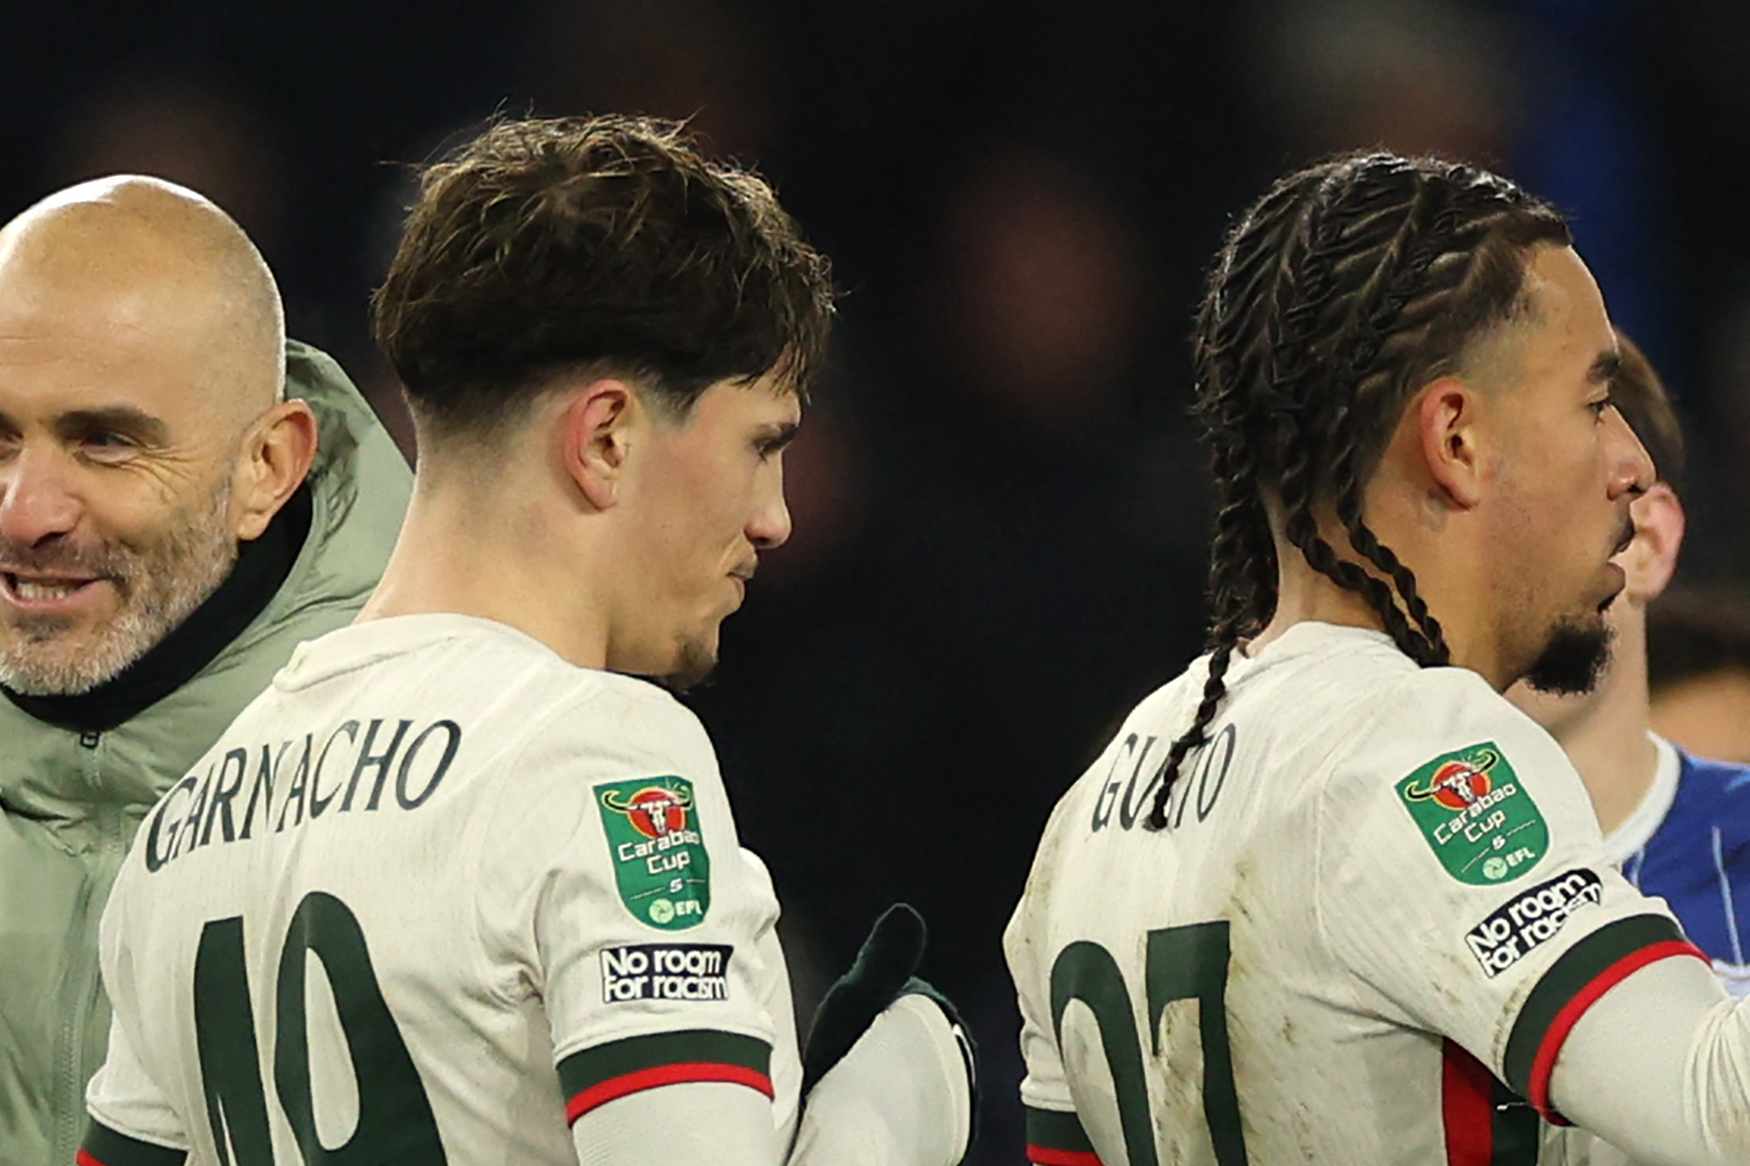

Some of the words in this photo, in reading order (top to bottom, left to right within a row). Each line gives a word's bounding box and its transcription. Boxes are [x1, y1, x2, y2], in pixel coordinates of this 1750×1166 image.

[145, 718, 462, 874] GARNACHO
[1091, 722, 1237, 833] GUTO
[1432, 783, 1518, 846] Carabao
[1463, 809, 1507, 843] Cup
[646, 850, 691, 875] Cup
[1505, 846, 1536, 868] EFL
[1465, 917, 1511, 959] No
[1507, 873, 1588, 927] room
[1518, 881, 1604, 949] racm
[600, 946, 649, 977] No
[653, 949, 722, 975] room
